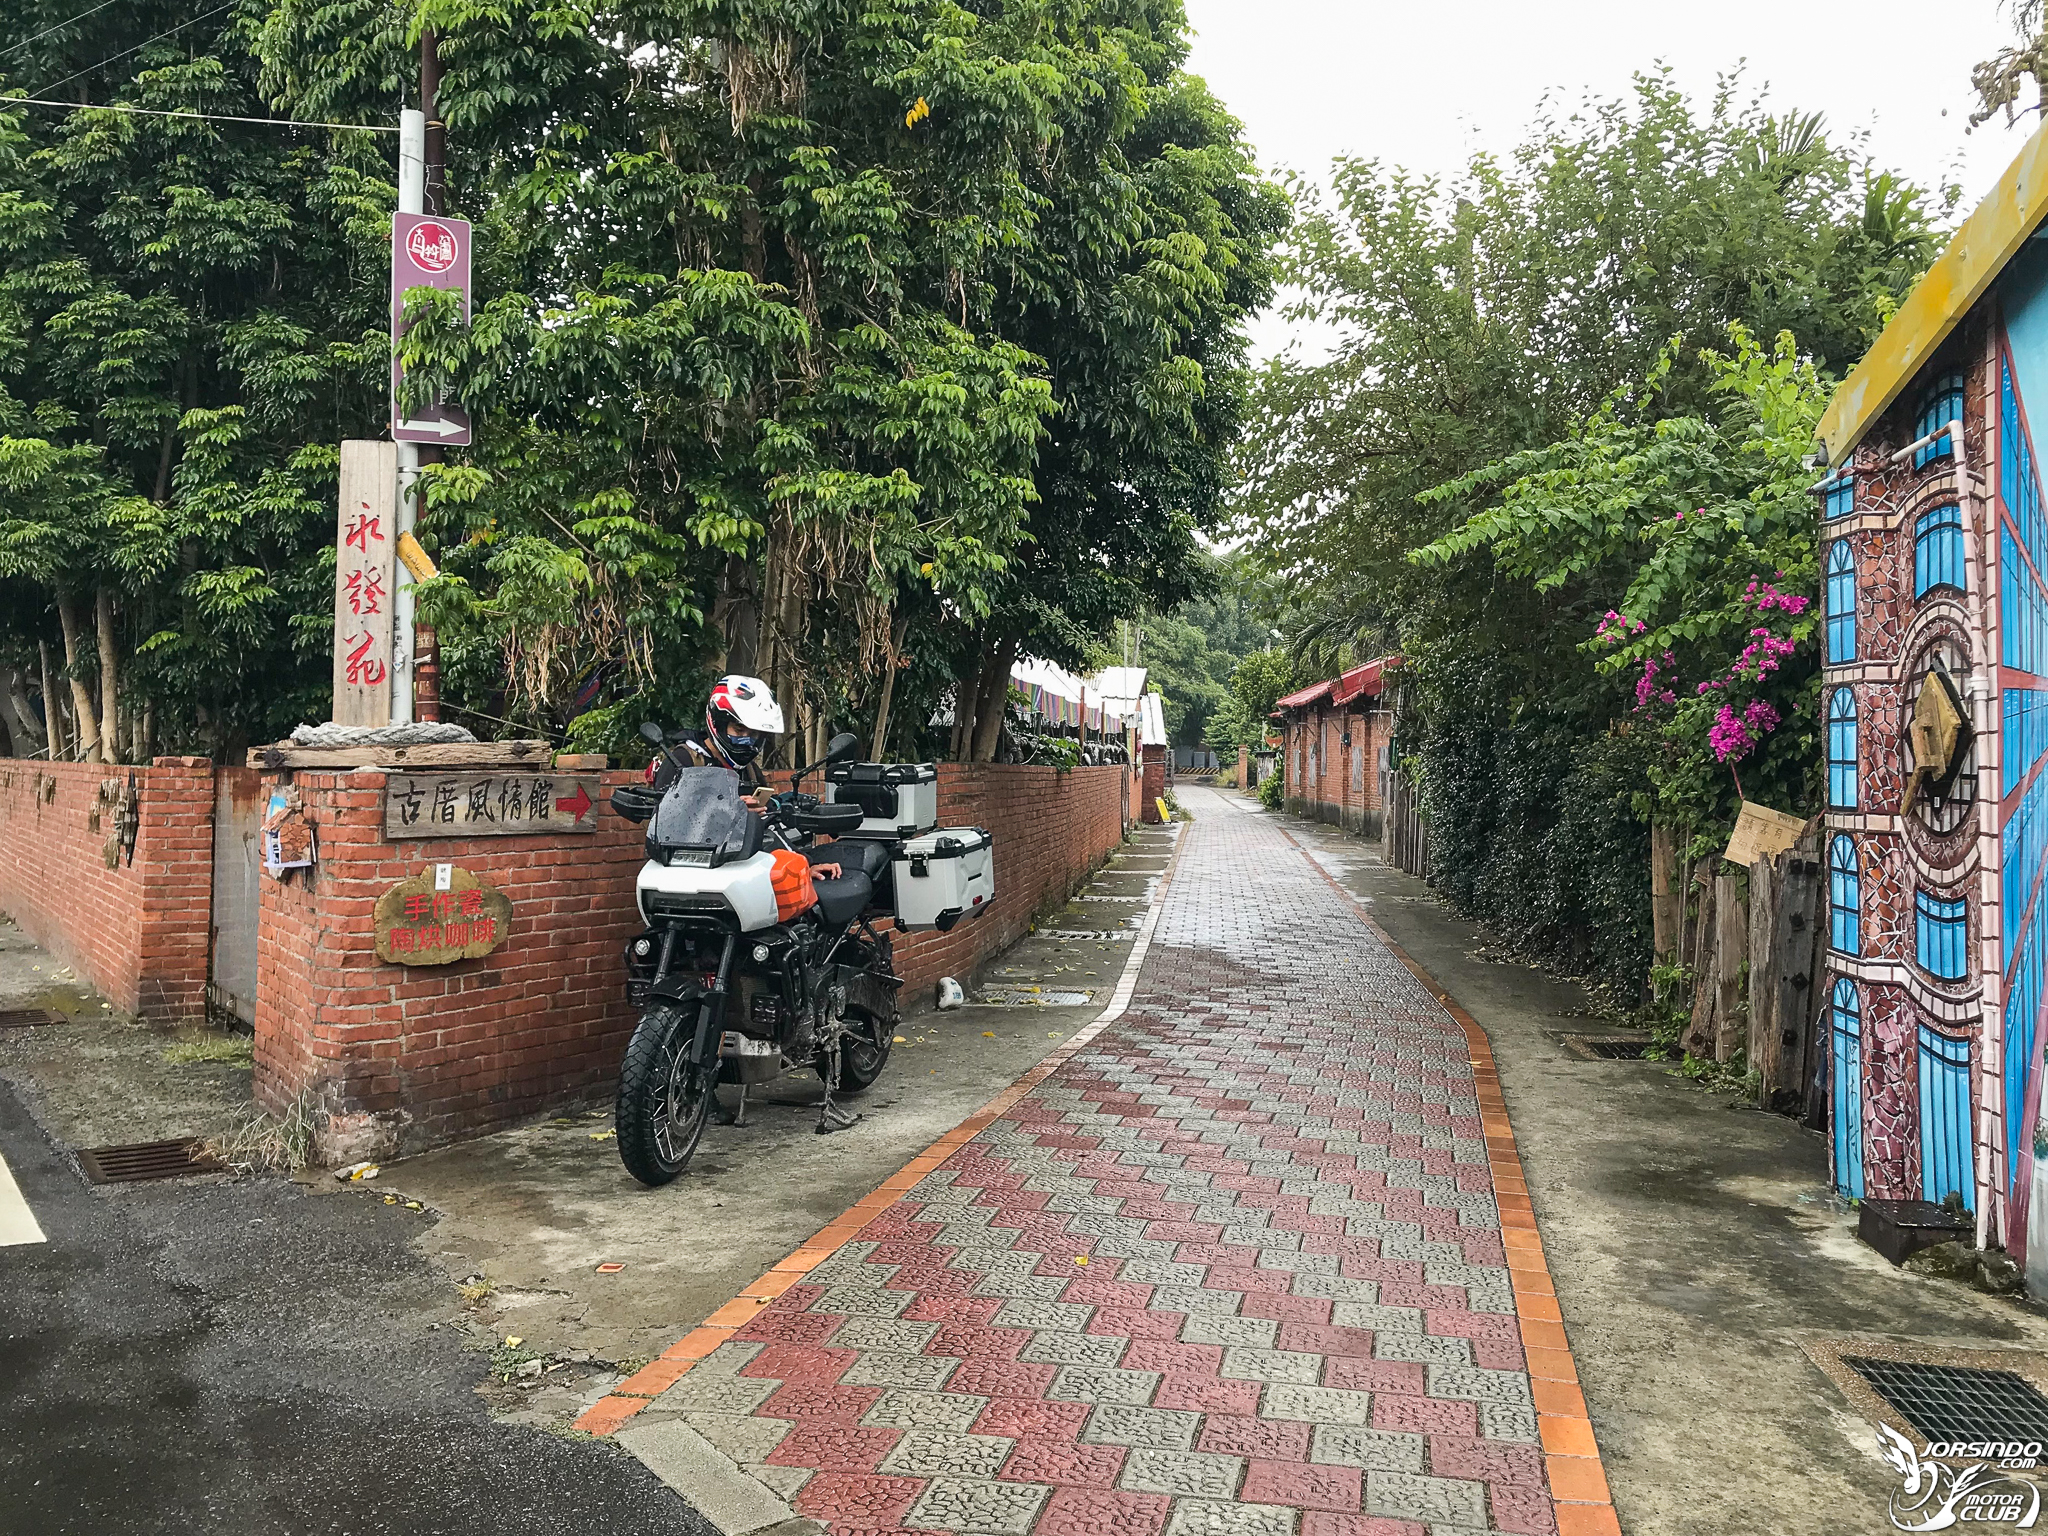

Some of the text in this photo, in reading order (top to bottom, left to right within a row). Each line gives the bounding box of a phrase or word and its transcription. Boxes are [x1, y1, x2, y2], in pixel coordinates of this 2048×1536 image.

[392, 777, 554, 826] 古厝風情館
[404, 889, 483, 921] 手作瓷
[389, 917, 496, 954] 陶烘咖啡
